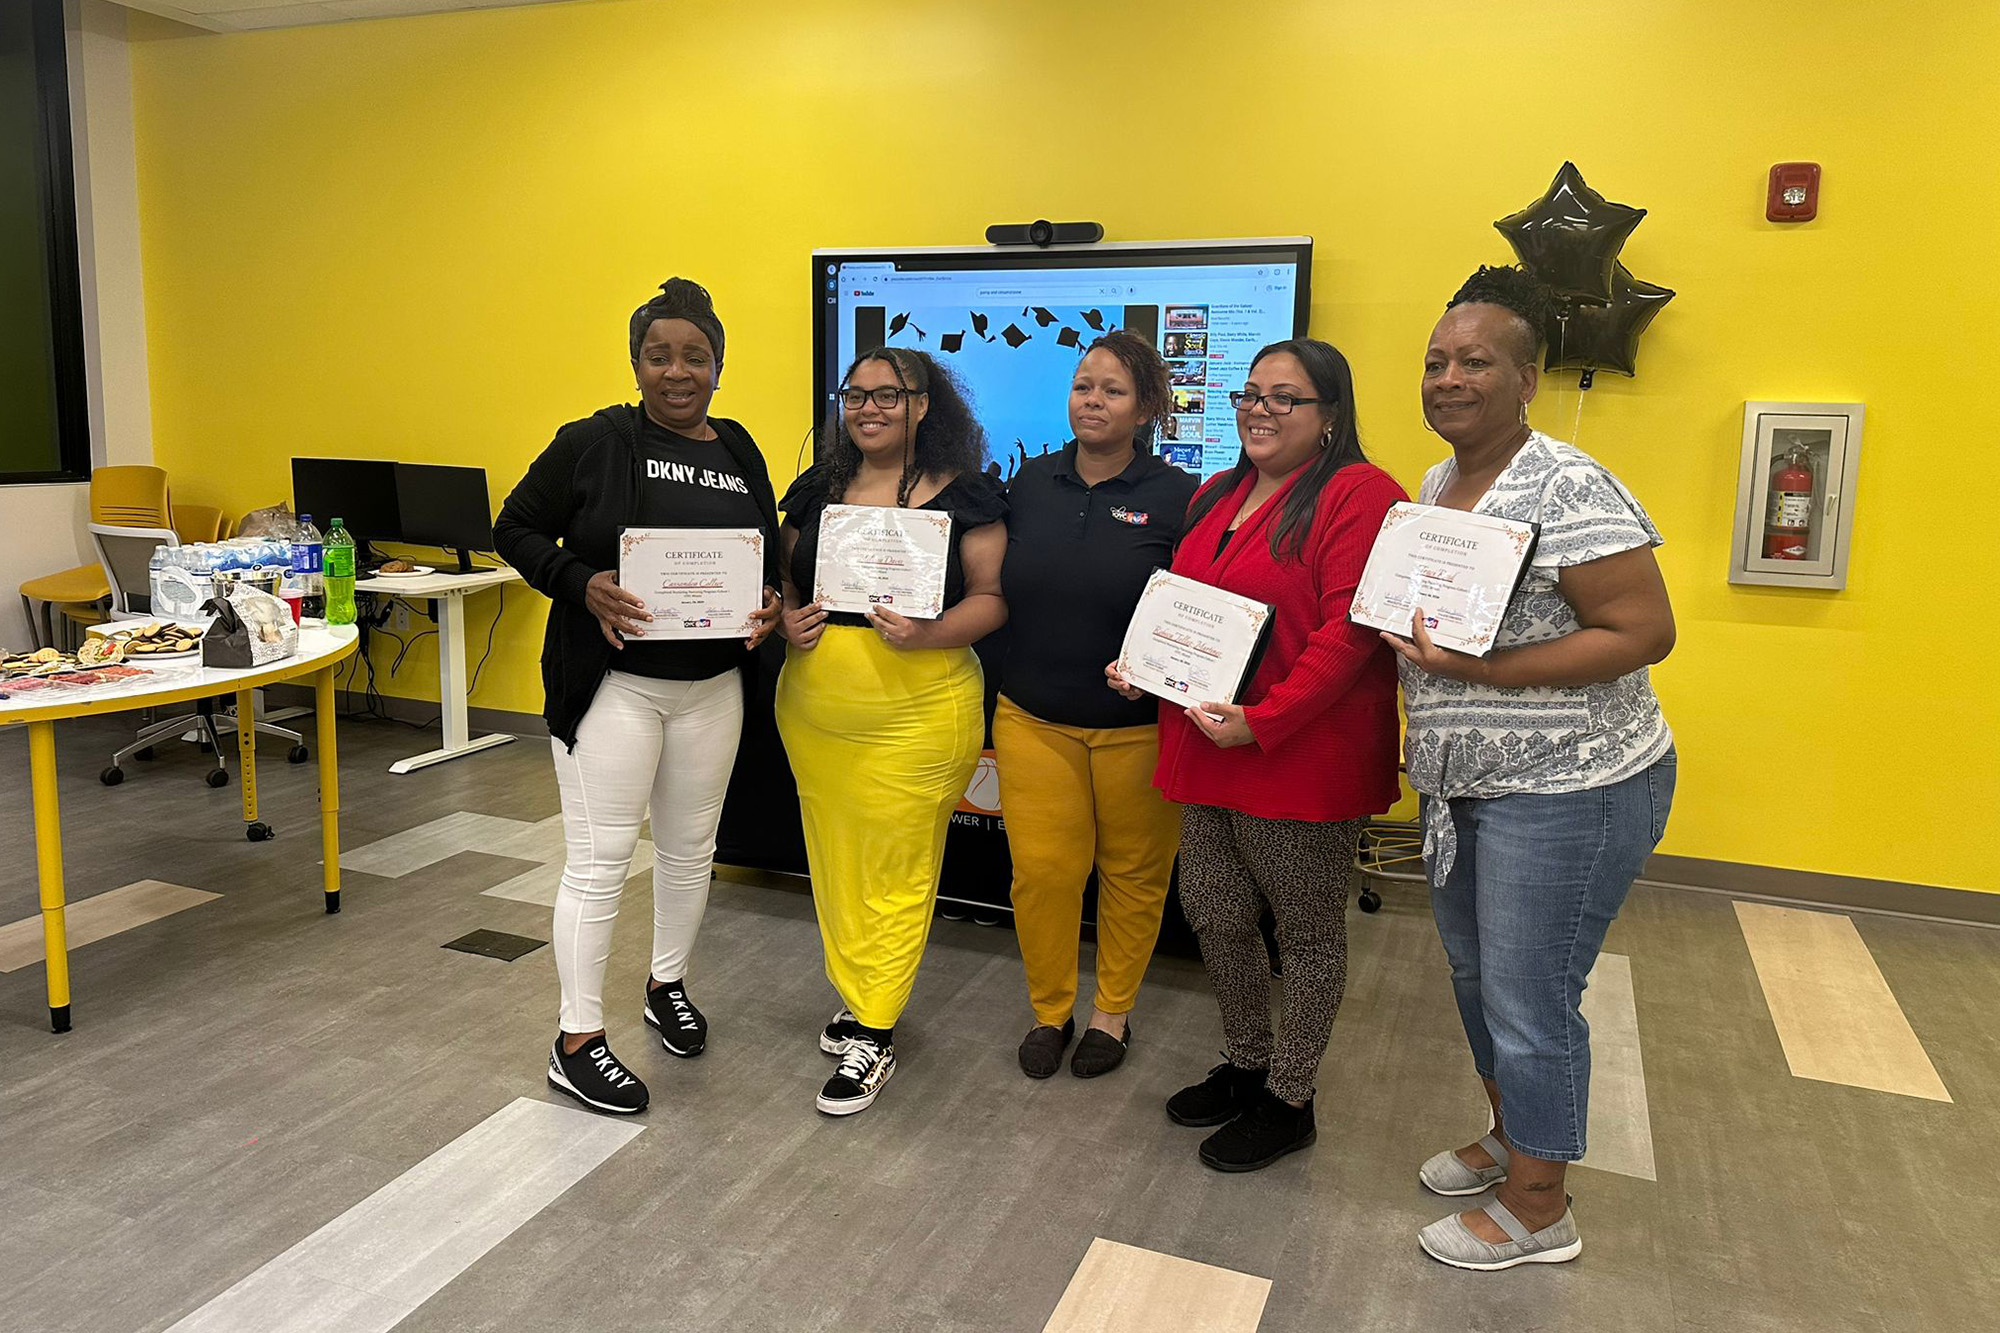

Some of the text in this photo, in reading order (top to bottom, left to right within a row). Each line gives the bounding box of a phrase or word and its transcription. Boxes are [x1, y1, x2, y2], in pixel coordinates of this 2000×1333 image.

[646, 459, 748, 494] DKNY JEANS
[1420, 531, 1478, 550] CERTIFICATE
[1433, 546, 1468, 556] COMPLETION
[665, 551, 724, 559] CERTIFICATE
[1174, 600, 1224, 624] CERTIFICATE
[668, 991, 699, 1030] DKNY
[590, 1046, 636, 1089] DKNY
